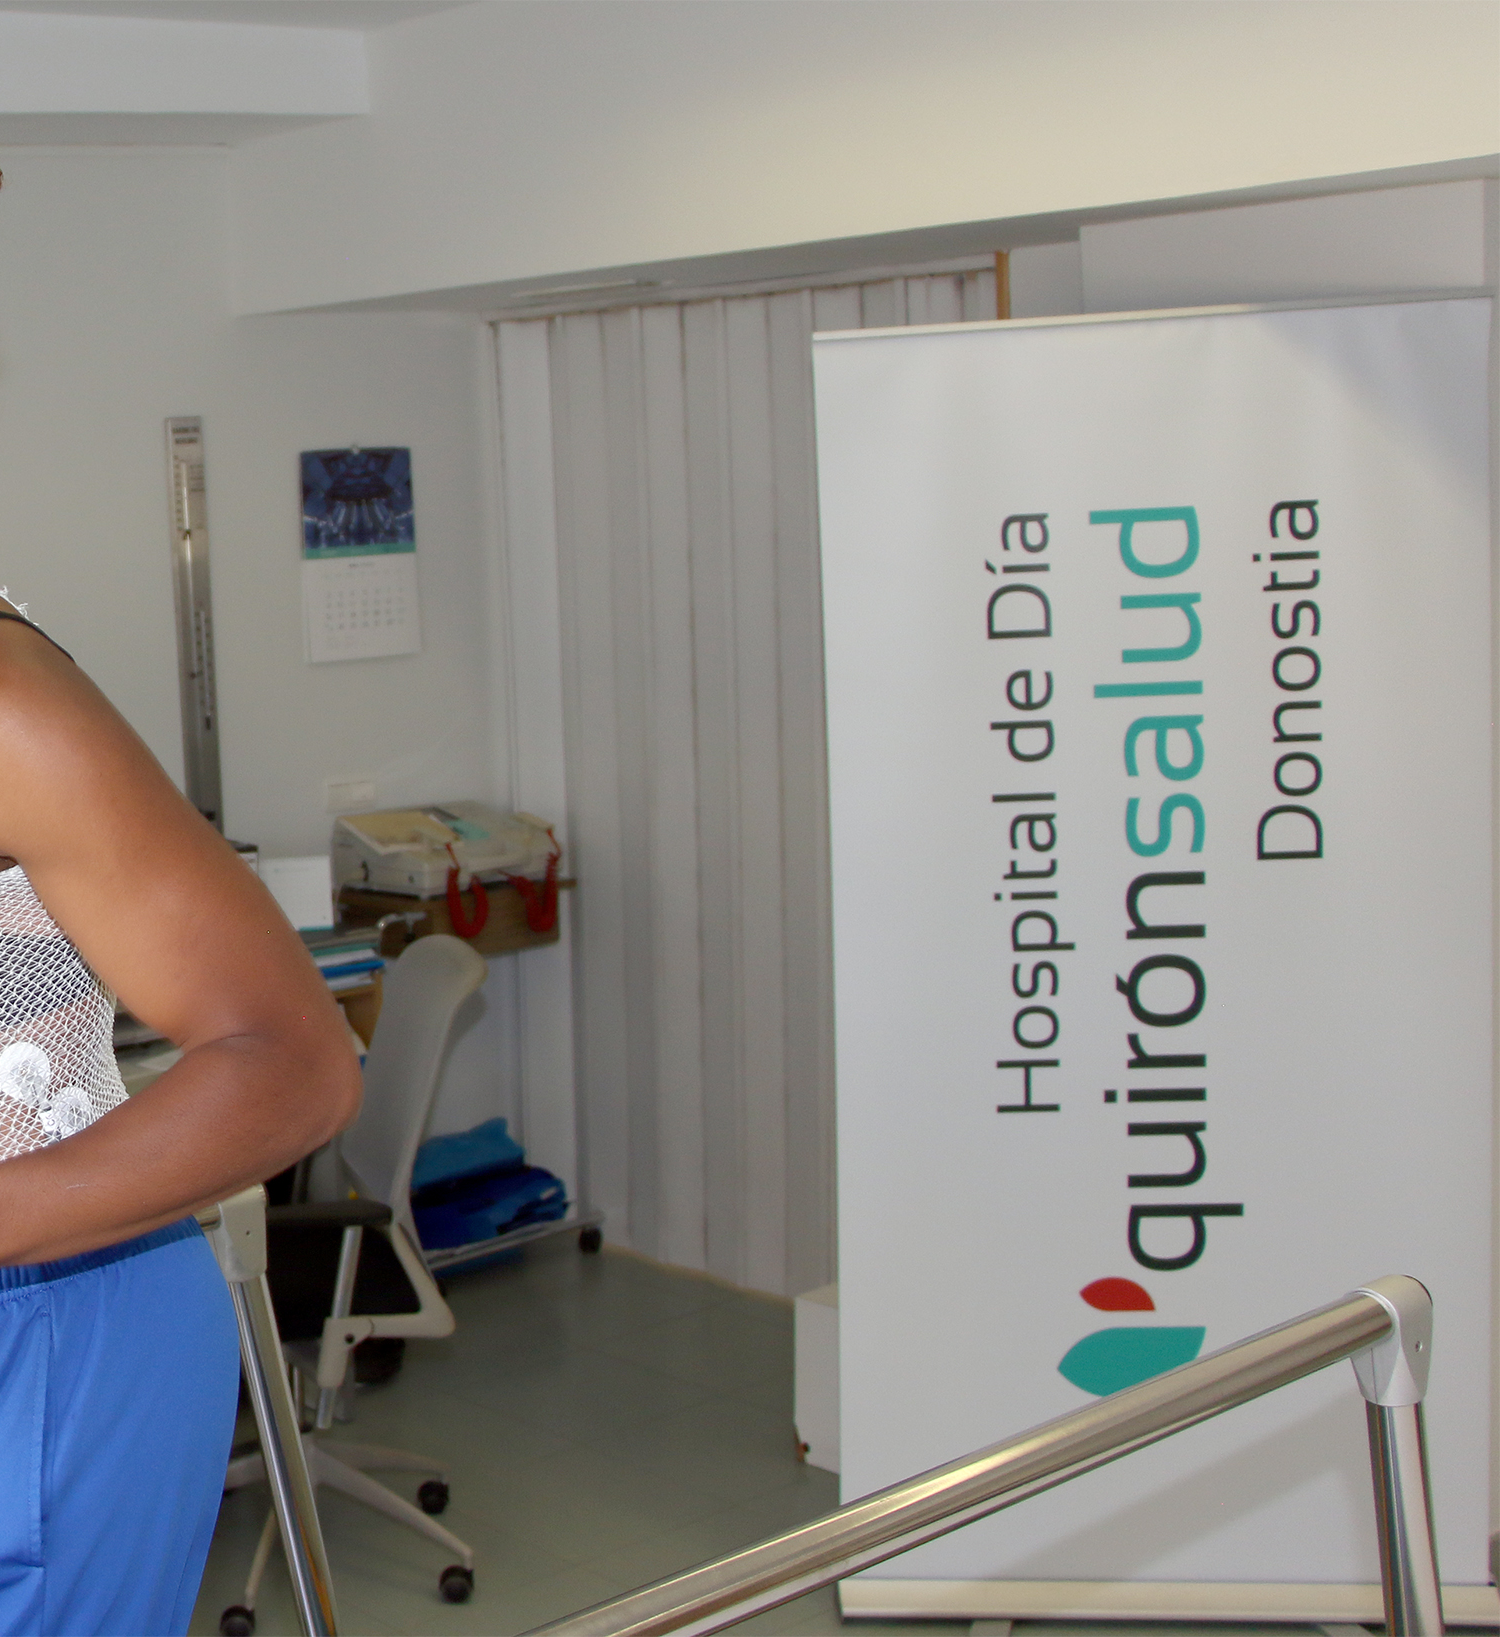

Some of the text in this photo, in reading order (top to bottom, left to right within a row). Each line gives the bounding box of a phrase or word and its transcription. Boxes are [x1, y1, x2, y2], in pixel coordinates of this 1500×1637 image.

[985, 512, 1077, 1115] Hospital de Día
[1088, 505, 1246, 1273] quirónsalud
[1253, 499, 1324, 862] Donostia
